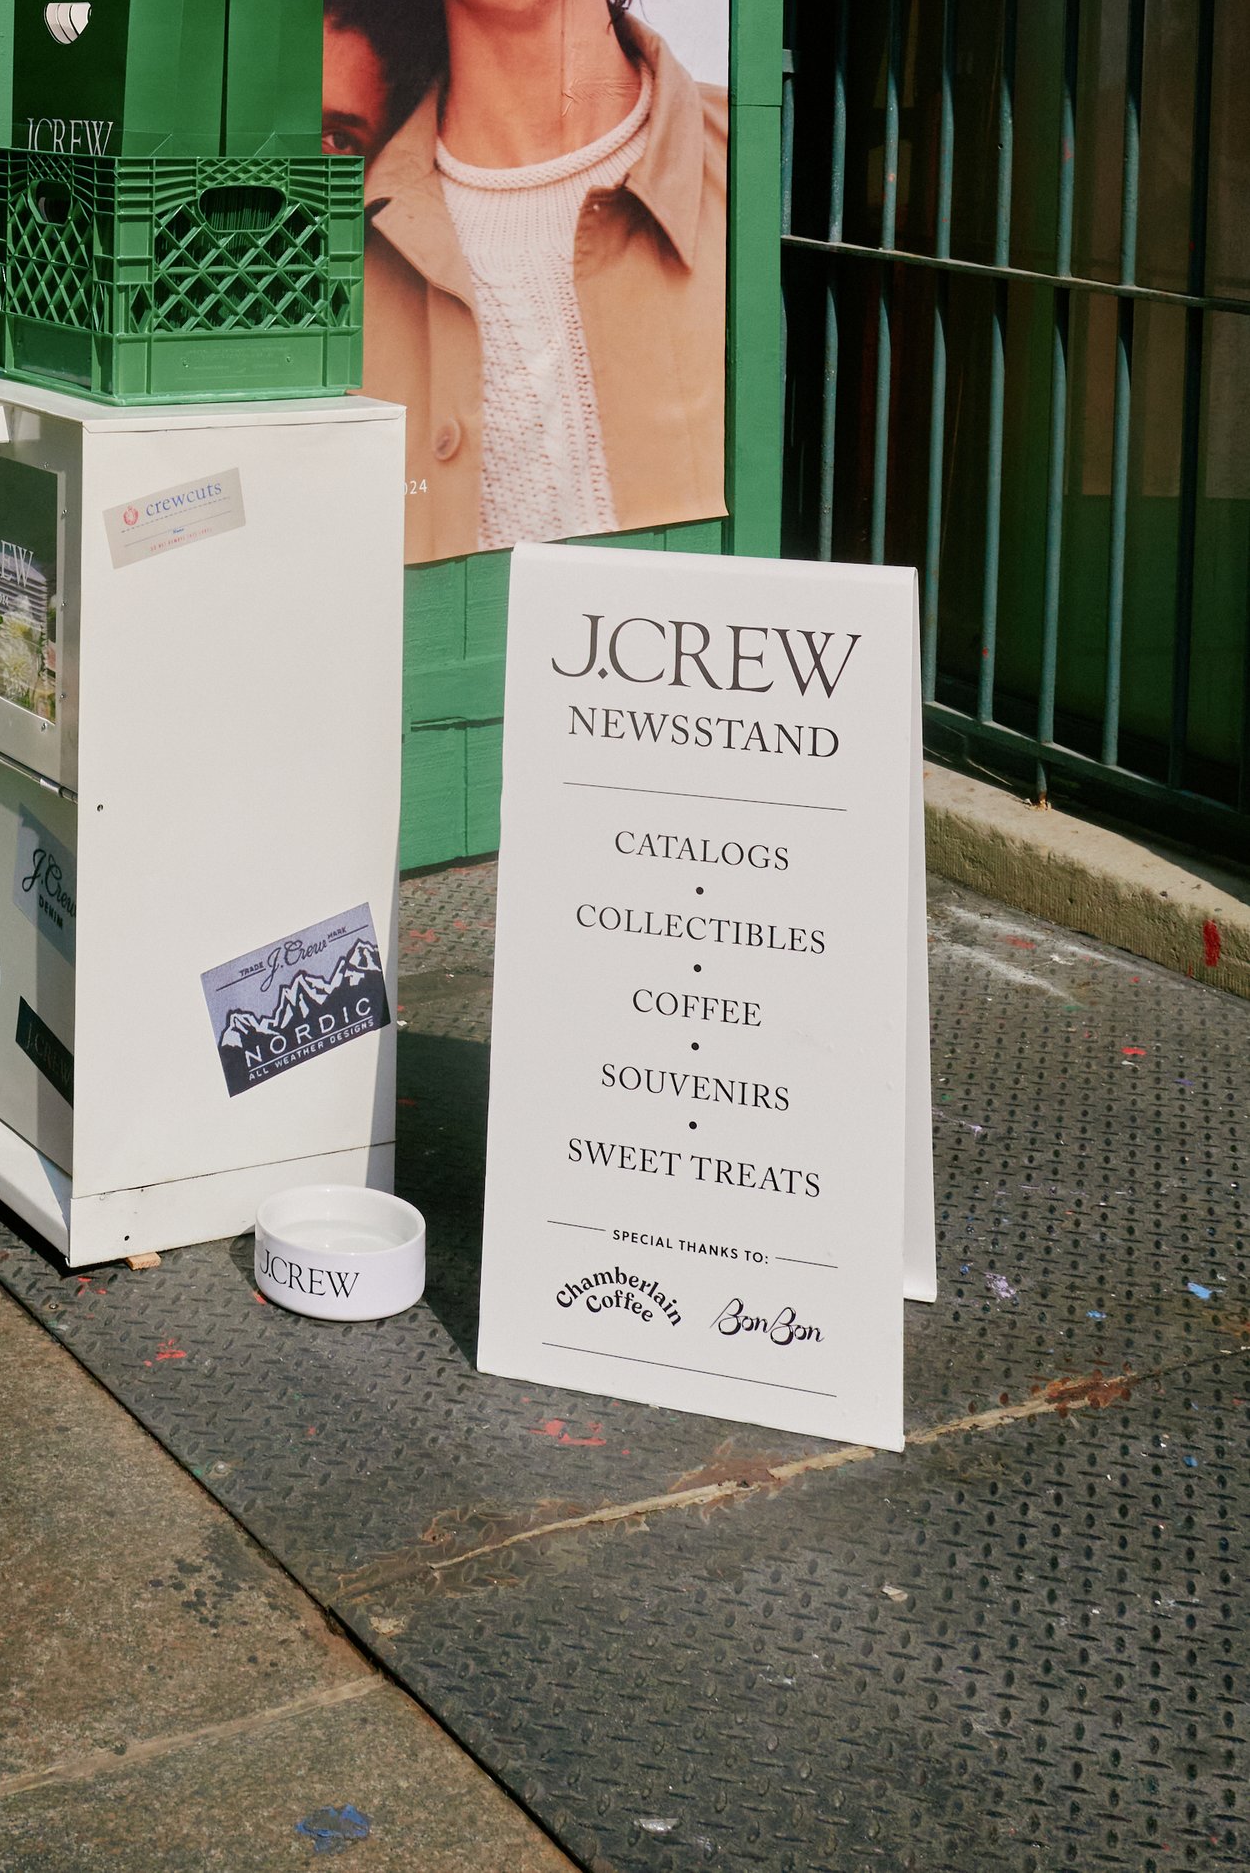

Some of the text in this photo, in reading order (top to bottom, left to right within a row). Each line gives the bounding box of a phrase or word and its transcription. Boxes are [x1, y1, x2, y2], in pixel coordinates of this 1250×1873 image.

[146, 482, 222, 517] crewcuts
[551, 613, 862, 699] J.CREW
[568, 705, 840, 758] NEWSSTAND
[614, 830, 790, 872] CATALOGS
[38, 893, 63, 931] DENIM
[576, 903, 826, 955] COLLECTIBLES
[239, 926, 347, 993] TRADE J.Crew MARK
[244, 997, 371, 1068] NORDIC
[632, 988, 762, 1027] COFFEE
[248, 1020, 374, 1081] ALL WEATHER DESIGNS
[601, 1063, 791, 1111] SOUVENIRS
[567, 1137, 821, 1198] SWEET TREATS
[612, 1229, 769, 1265] SPECIAL THANKS TO:
[259, 1249, 360, 1299] J.CREW
[555, 1266, 682, 1327] Chamberlain
[585, 1289, 654, 1323] Coffee
[710, 1297, 825, 1346] BonBon
